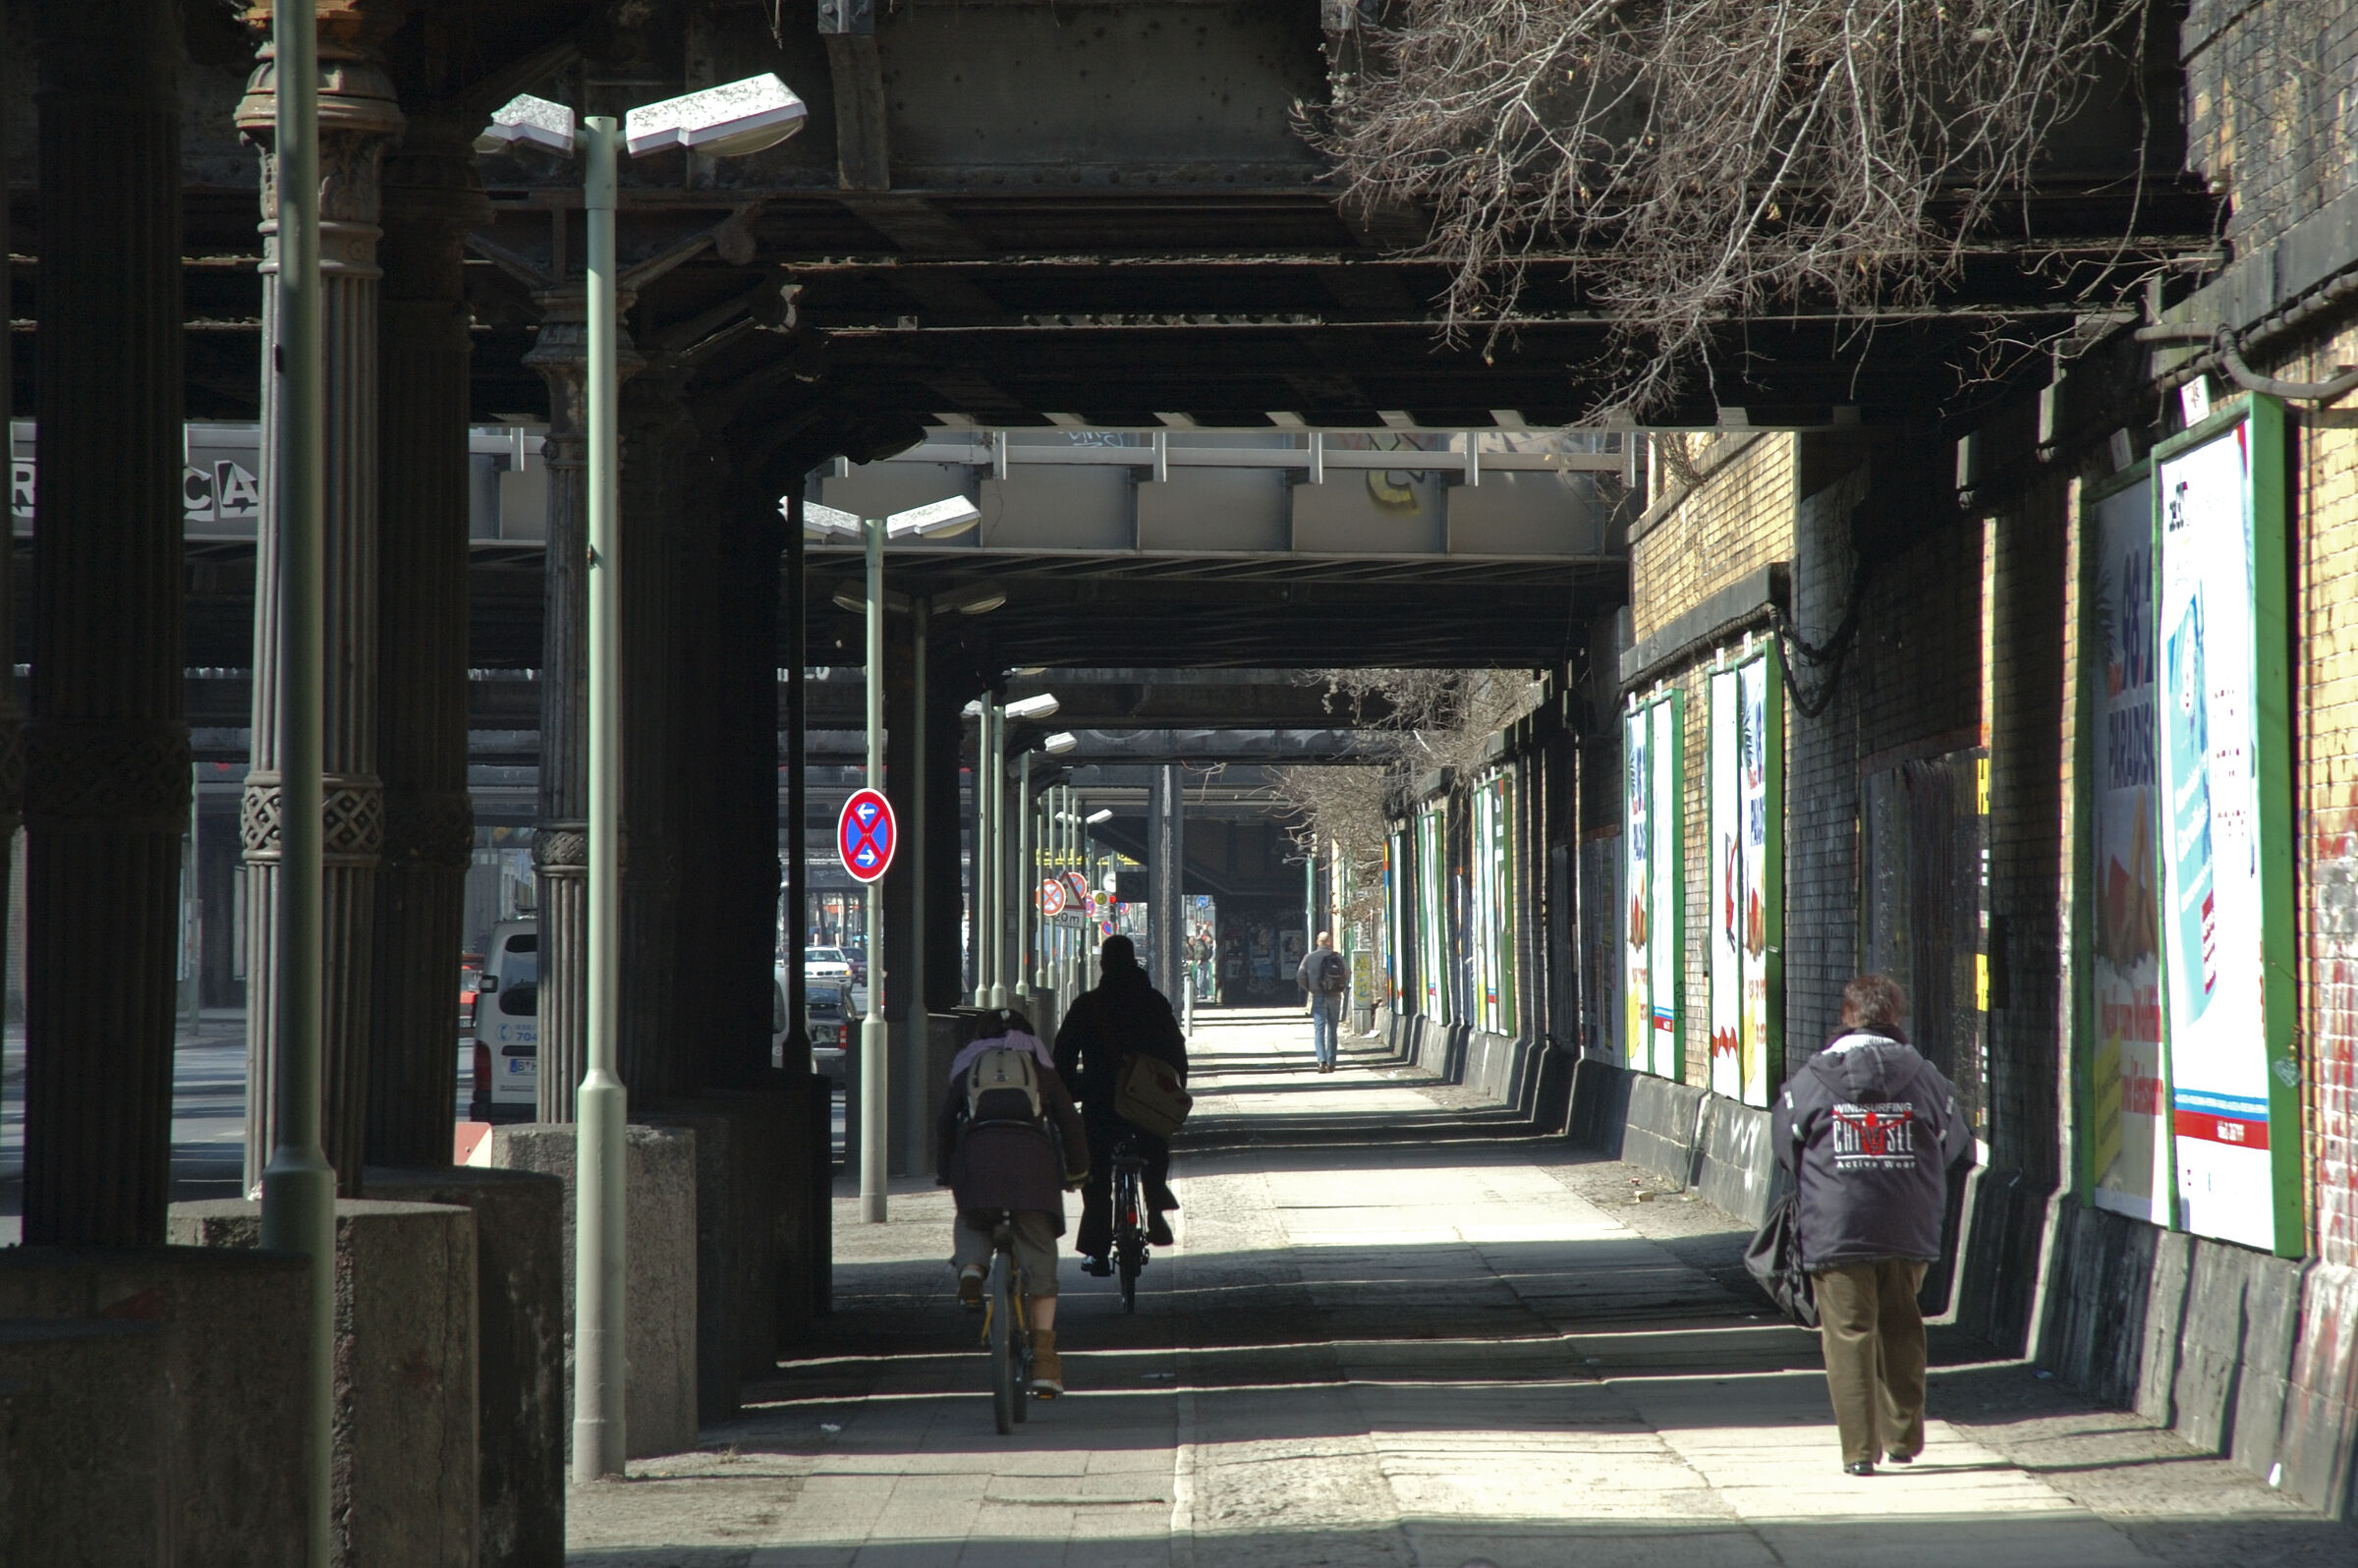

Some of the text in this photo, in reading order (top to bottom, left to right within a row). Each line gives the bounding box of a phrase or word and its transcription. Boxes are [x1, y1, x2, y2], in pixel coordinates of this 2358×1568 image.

[1832, 1102, 1913, 1112] WINDSURFING
[1833, 1120, 1914, 1152] CHISEE
[1836, 1160, 1878, 1169] Active
